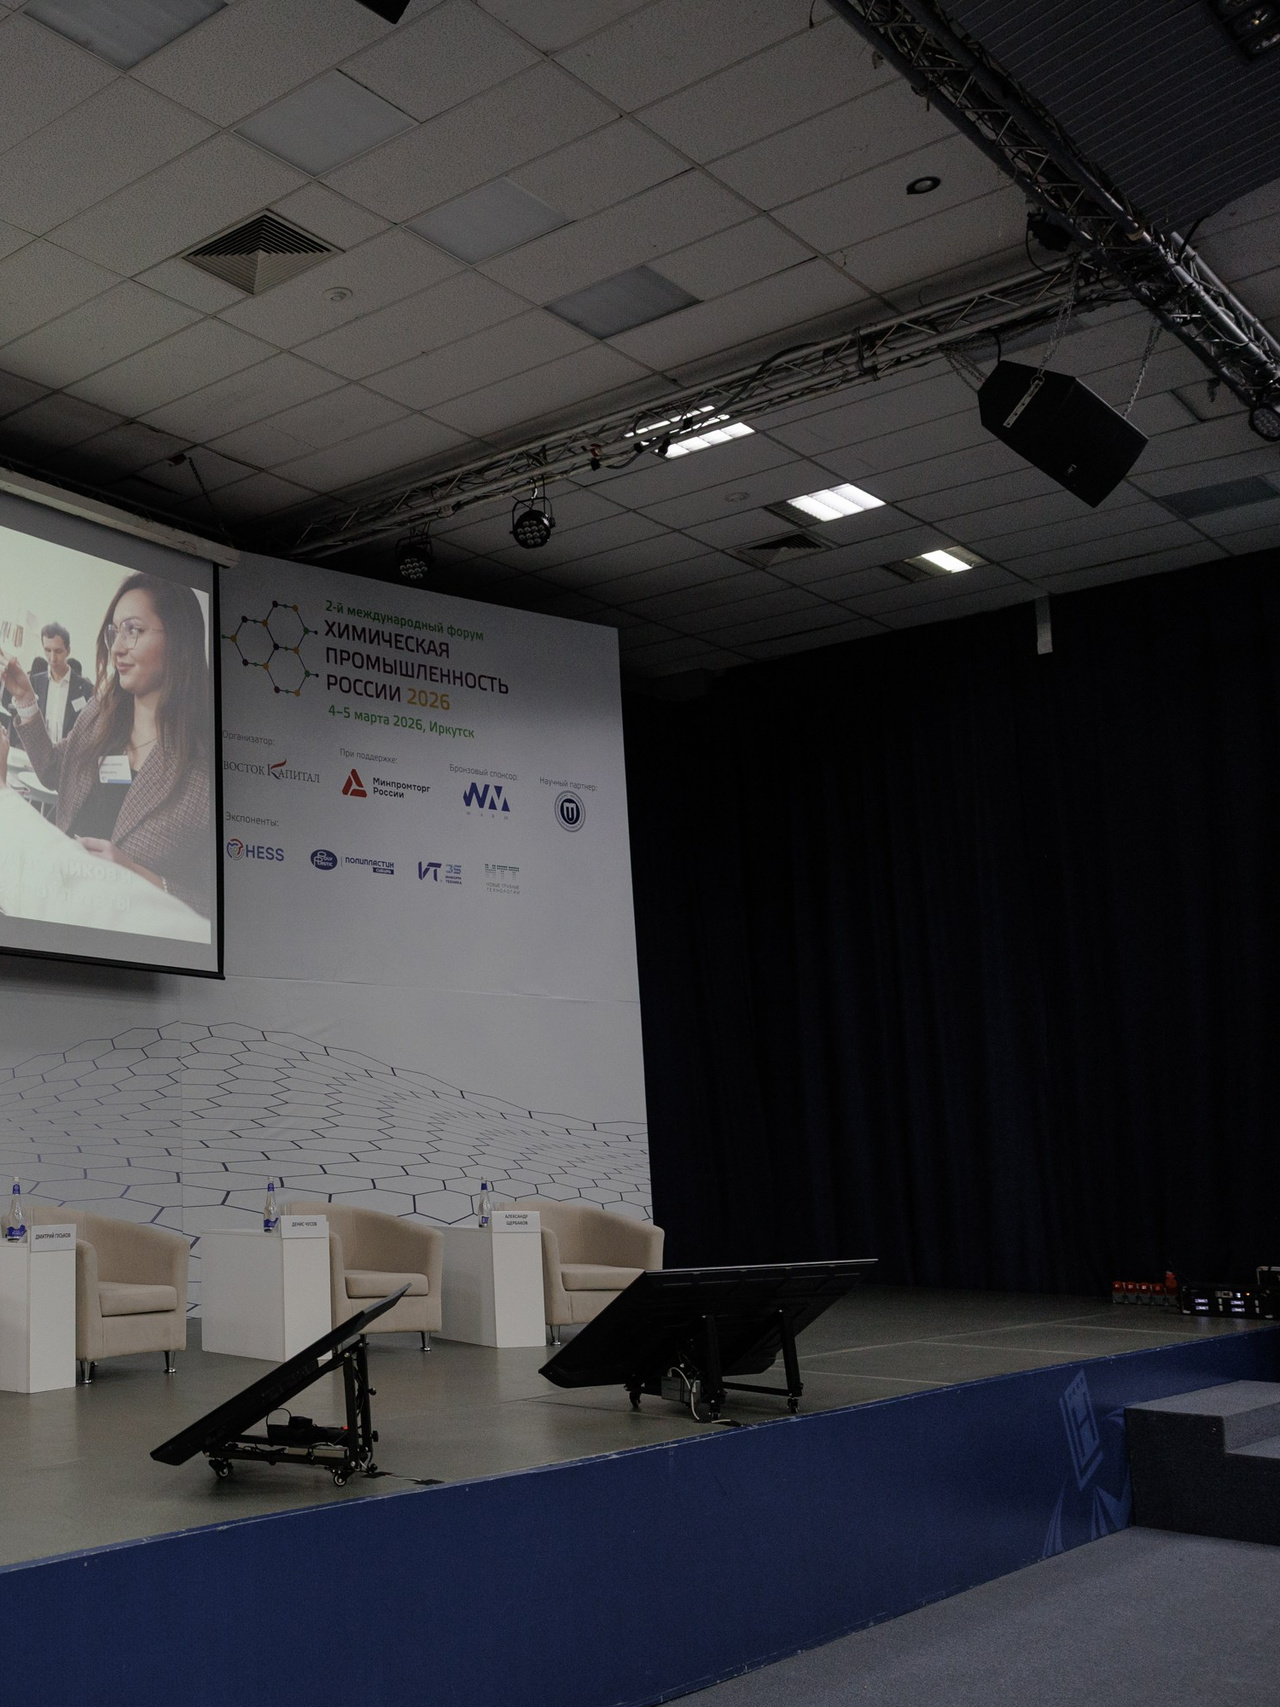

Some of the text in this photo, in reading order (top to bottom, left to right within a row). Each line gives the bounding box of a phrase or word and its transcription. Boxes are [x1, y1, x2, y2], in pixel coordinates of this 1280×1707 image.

[325, 600, 484, 642] 2-й международный форум
[324, 619, 450, 659] ХИМИЧЕСКАЯ
[325, 646, 509, 695] ПРОМЫШЛЕННОСТЬ
[326, 673, 451, 711] РОССИИ 2026
[354, 712, 390, 726] марта
[393, 714, 426, 733] 2026,
[429, 720, 475, 739] Иркутск
[222, 729, 275, 746] Организатор:
[339, 748, 398, 765] При поддержке:
[223, 758, 320, 784] ВОСТОК КАПИТАЛ
[449, 763, 519, 782] Бронзовый спонсор:
[372, 777, 431, 793] Минпромторг
[539, 776, 569, 788] Научный
[372, 787, 405, 799] России
[225, 811, 279, 828] Экспоненты:
[245, 844, 284, 862] HESS
